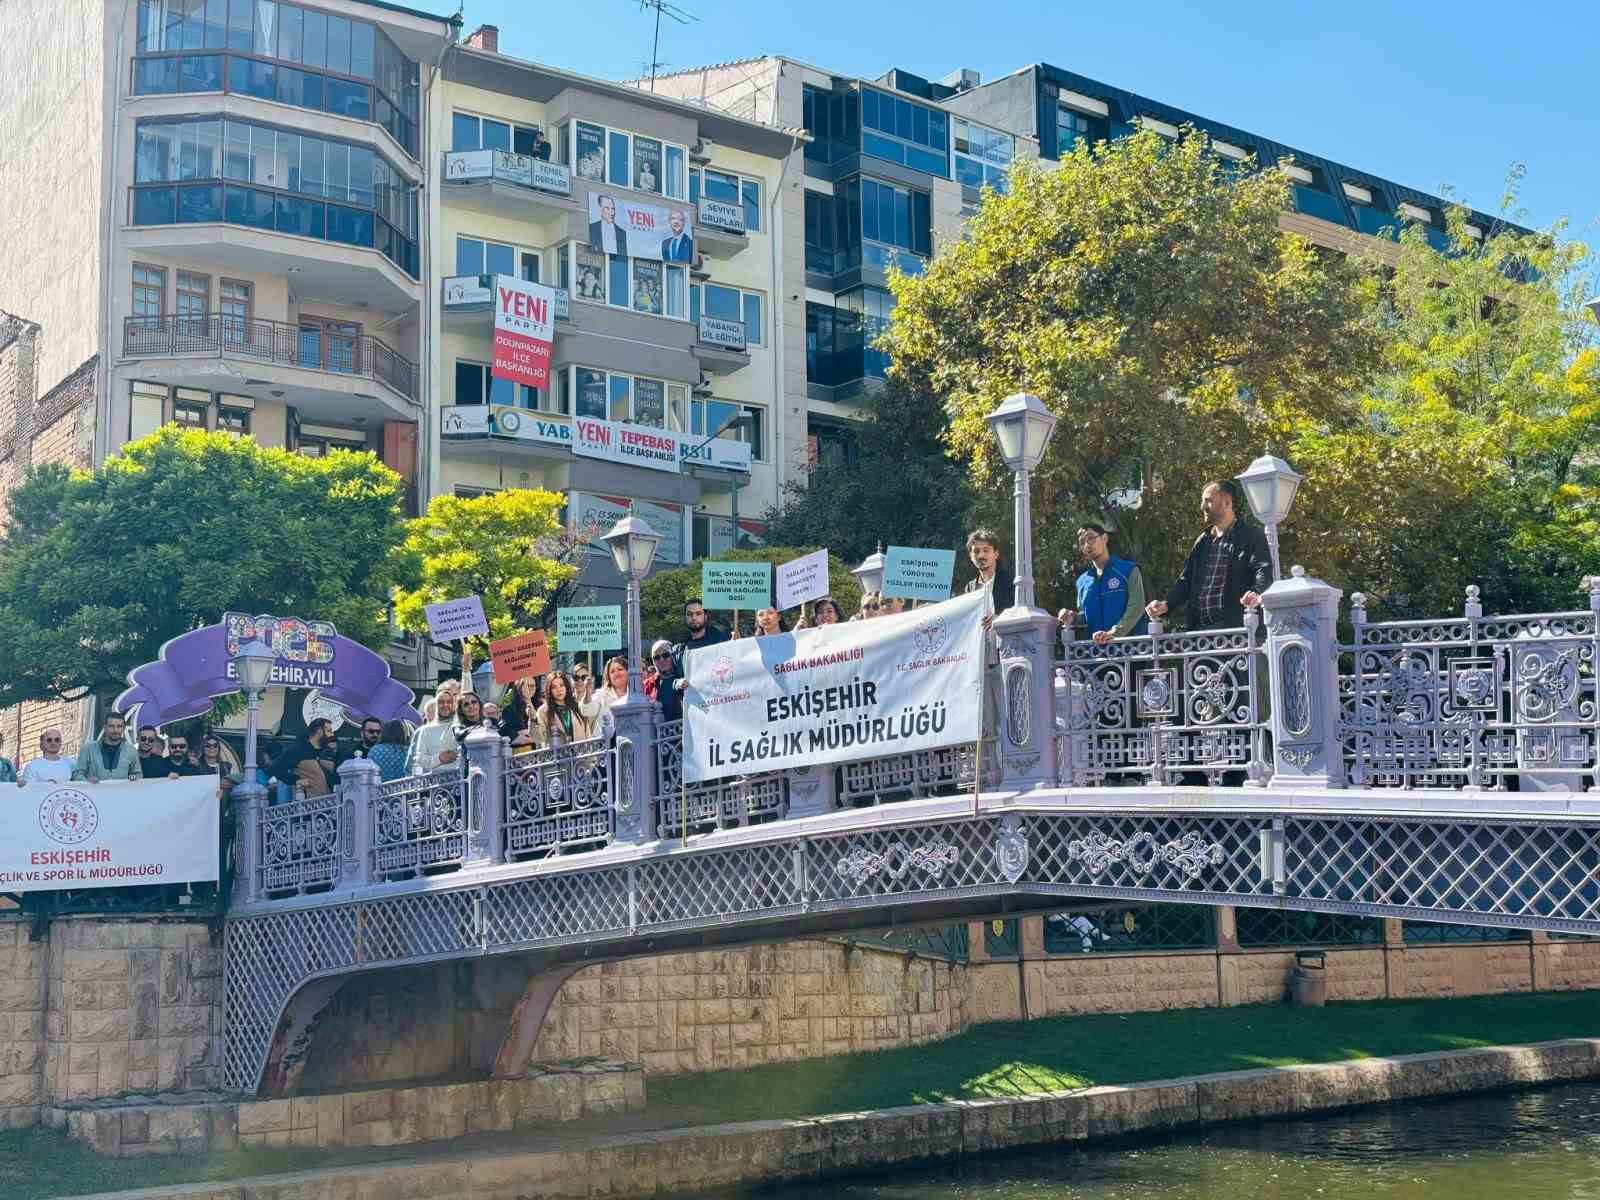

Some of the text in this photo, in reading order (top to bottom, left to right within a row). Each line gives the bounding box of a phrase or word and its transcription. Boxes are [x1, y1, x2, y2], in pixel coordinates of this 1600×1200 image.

[539, 165, 563, 176] TEMEL
[702, 214, 743, 229] GRUPLARI
[499, 287, 548, 325] YENİ
[576, 420, 611, 446] YENİ
[619, 430, 676, 452] TEPEBAŞI
[774, 647, 864, 674] SAĞLIK BAKANLIĞI
[909, 658, 932, 671] SAĞLIK
[767, 676, 878, 722] ESKİŞEHİR
[709, 700, 947, 767] İL SAĞLIK MÜDÜRLÜĞÜ
[31, 846, 111, 867] ESKİŞEHİR
[27, 872, 40, 882] VE
[43, 870, 74, 881] SPOR
[76, 868, 87, 880] İL
[89, 863, 163, 879] MÜDÜRLÜĞÜ
